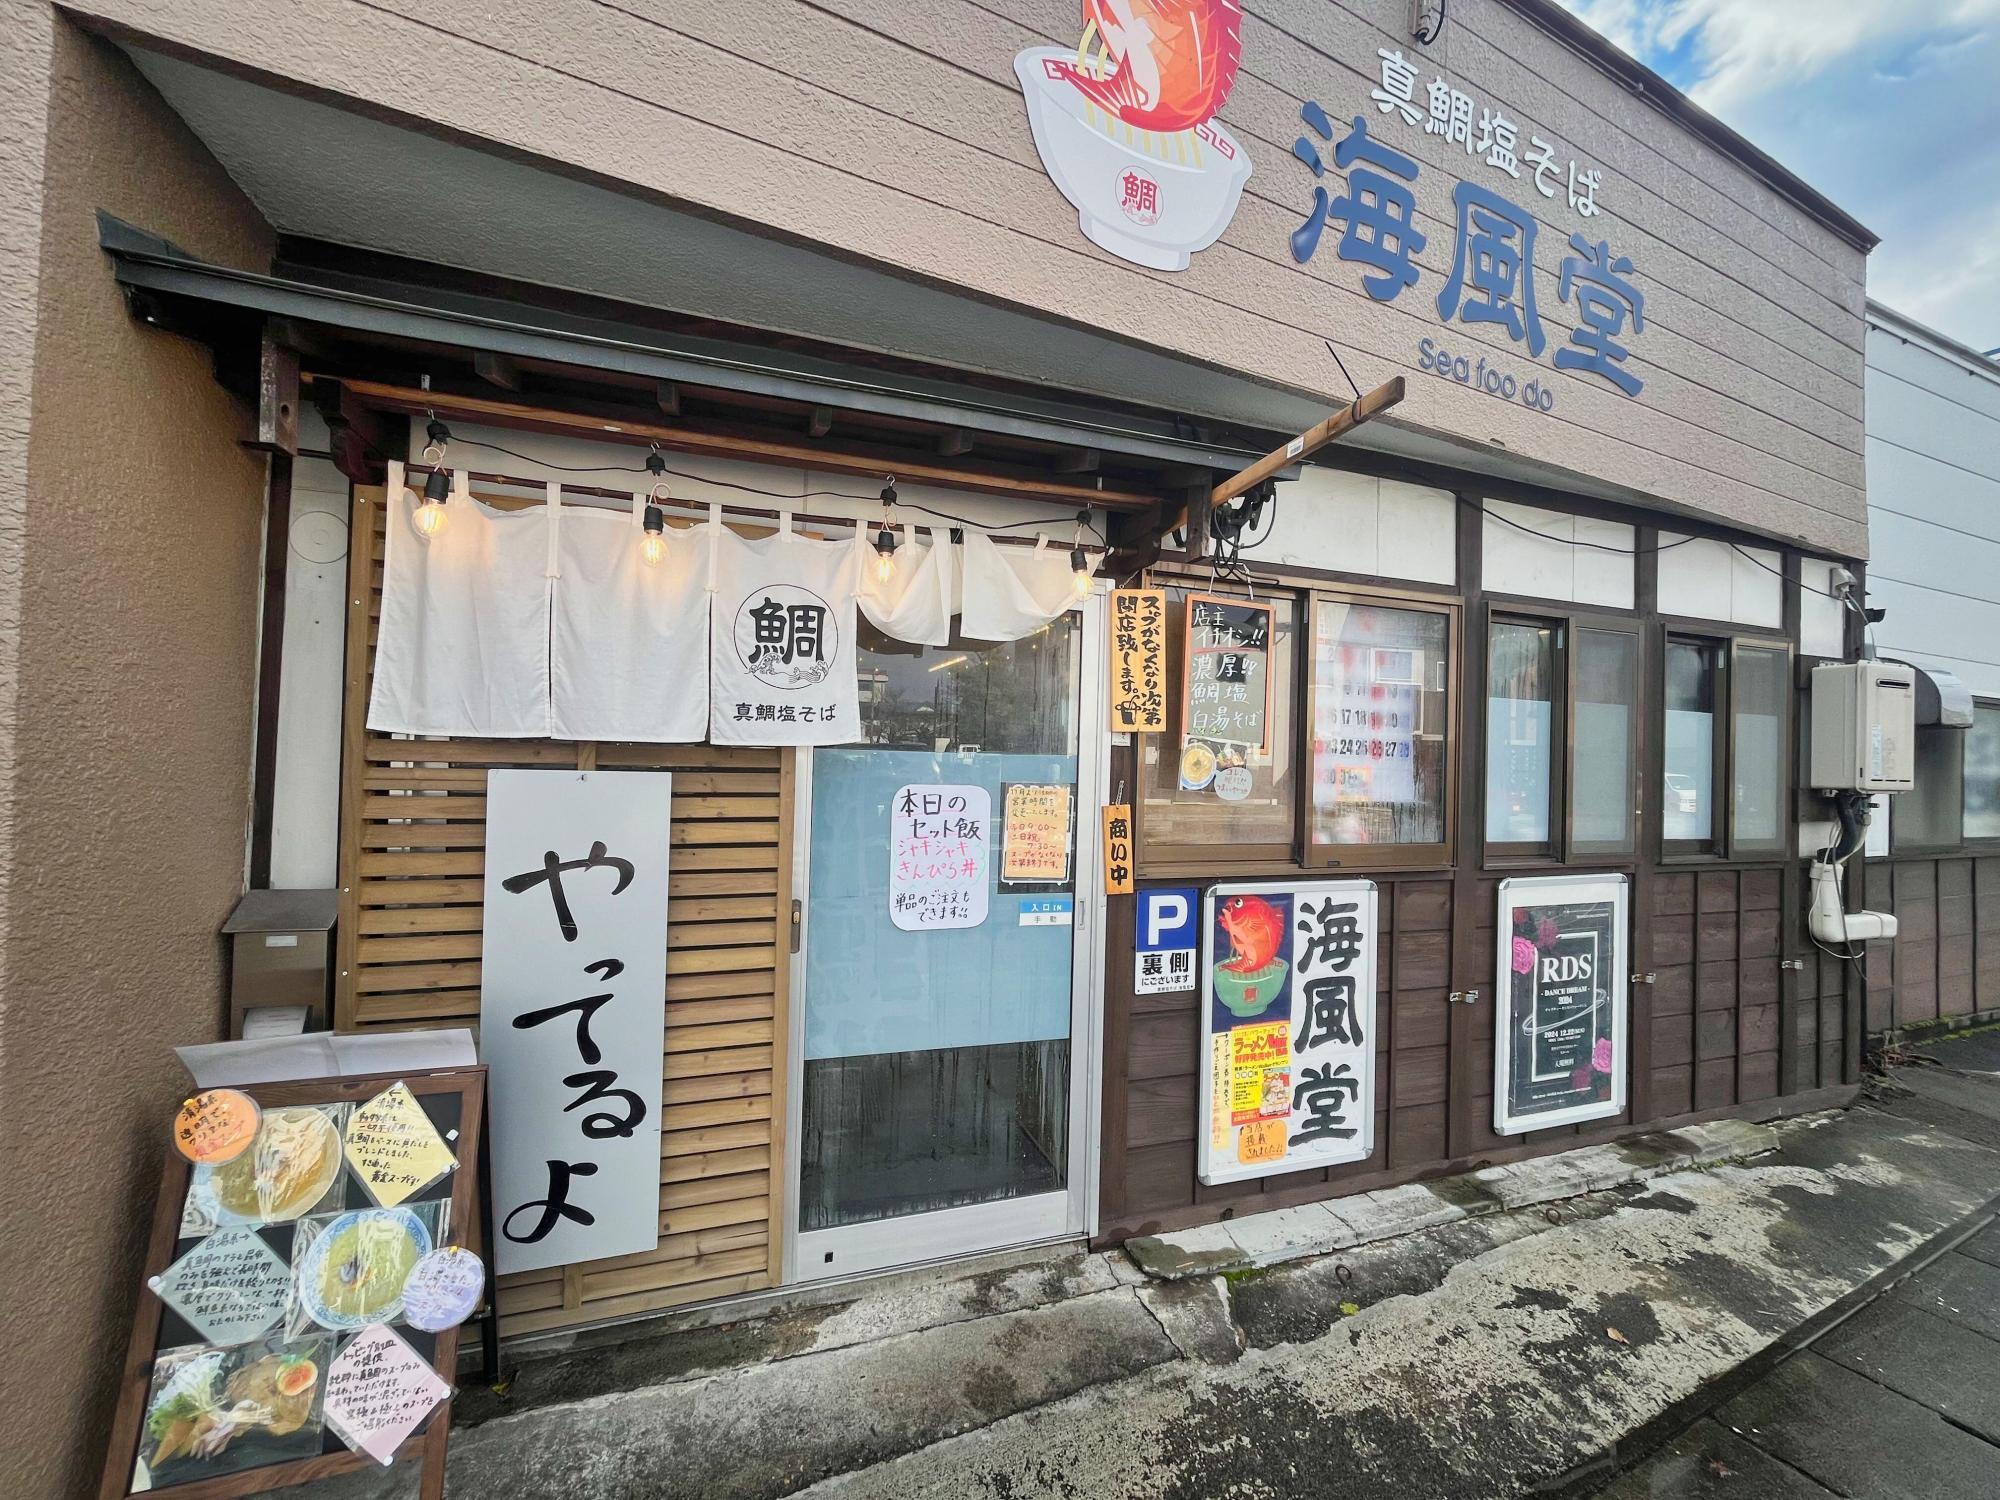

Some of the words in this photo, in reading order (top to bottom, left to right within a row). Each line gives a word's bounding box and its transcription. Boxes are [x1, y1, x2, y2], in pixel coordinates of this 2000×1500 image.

[1371, 47, 1602, 218] 真鯛塩そば
[1122, 171, 1157, 214] 鯛
[1290, 101, 1645, 397] 海風堂
[1193, 604, 1225, 627] 店主
[748, 596, 826, 665] 鯛
[1190, 683, 1251, 706] 鯛塩
[733, 702, 837, 723] 真鯛塩そば
[1193, 706, 1264, 730] 白湯そば
[1340, 740, 1353, 755] 24
[1385, 742, 1397, 758] 27
[900, 789, 967, 817] 本日の
[910, 818, 984, 840] セット飯
[897, 840, 969, 857] シャキシャキ
[1109, 818, 1128, 886] 商い中
[896, 860, 978, 881] きんぴら丼
[895, 888, 970, 912] 単品のご注文も
[1031, 903, 1050, 912] 入口
[1148, 895, 1188, 945] P
[1142, 952, 1189, 975] 裏側
[1541, 953, 1592, 984] RDS
[1141, 975, 1190, 986] にございます
[1288, 897, 1364, 1147] 海風堂
[501, 840, 647, 1243] やってるよ
